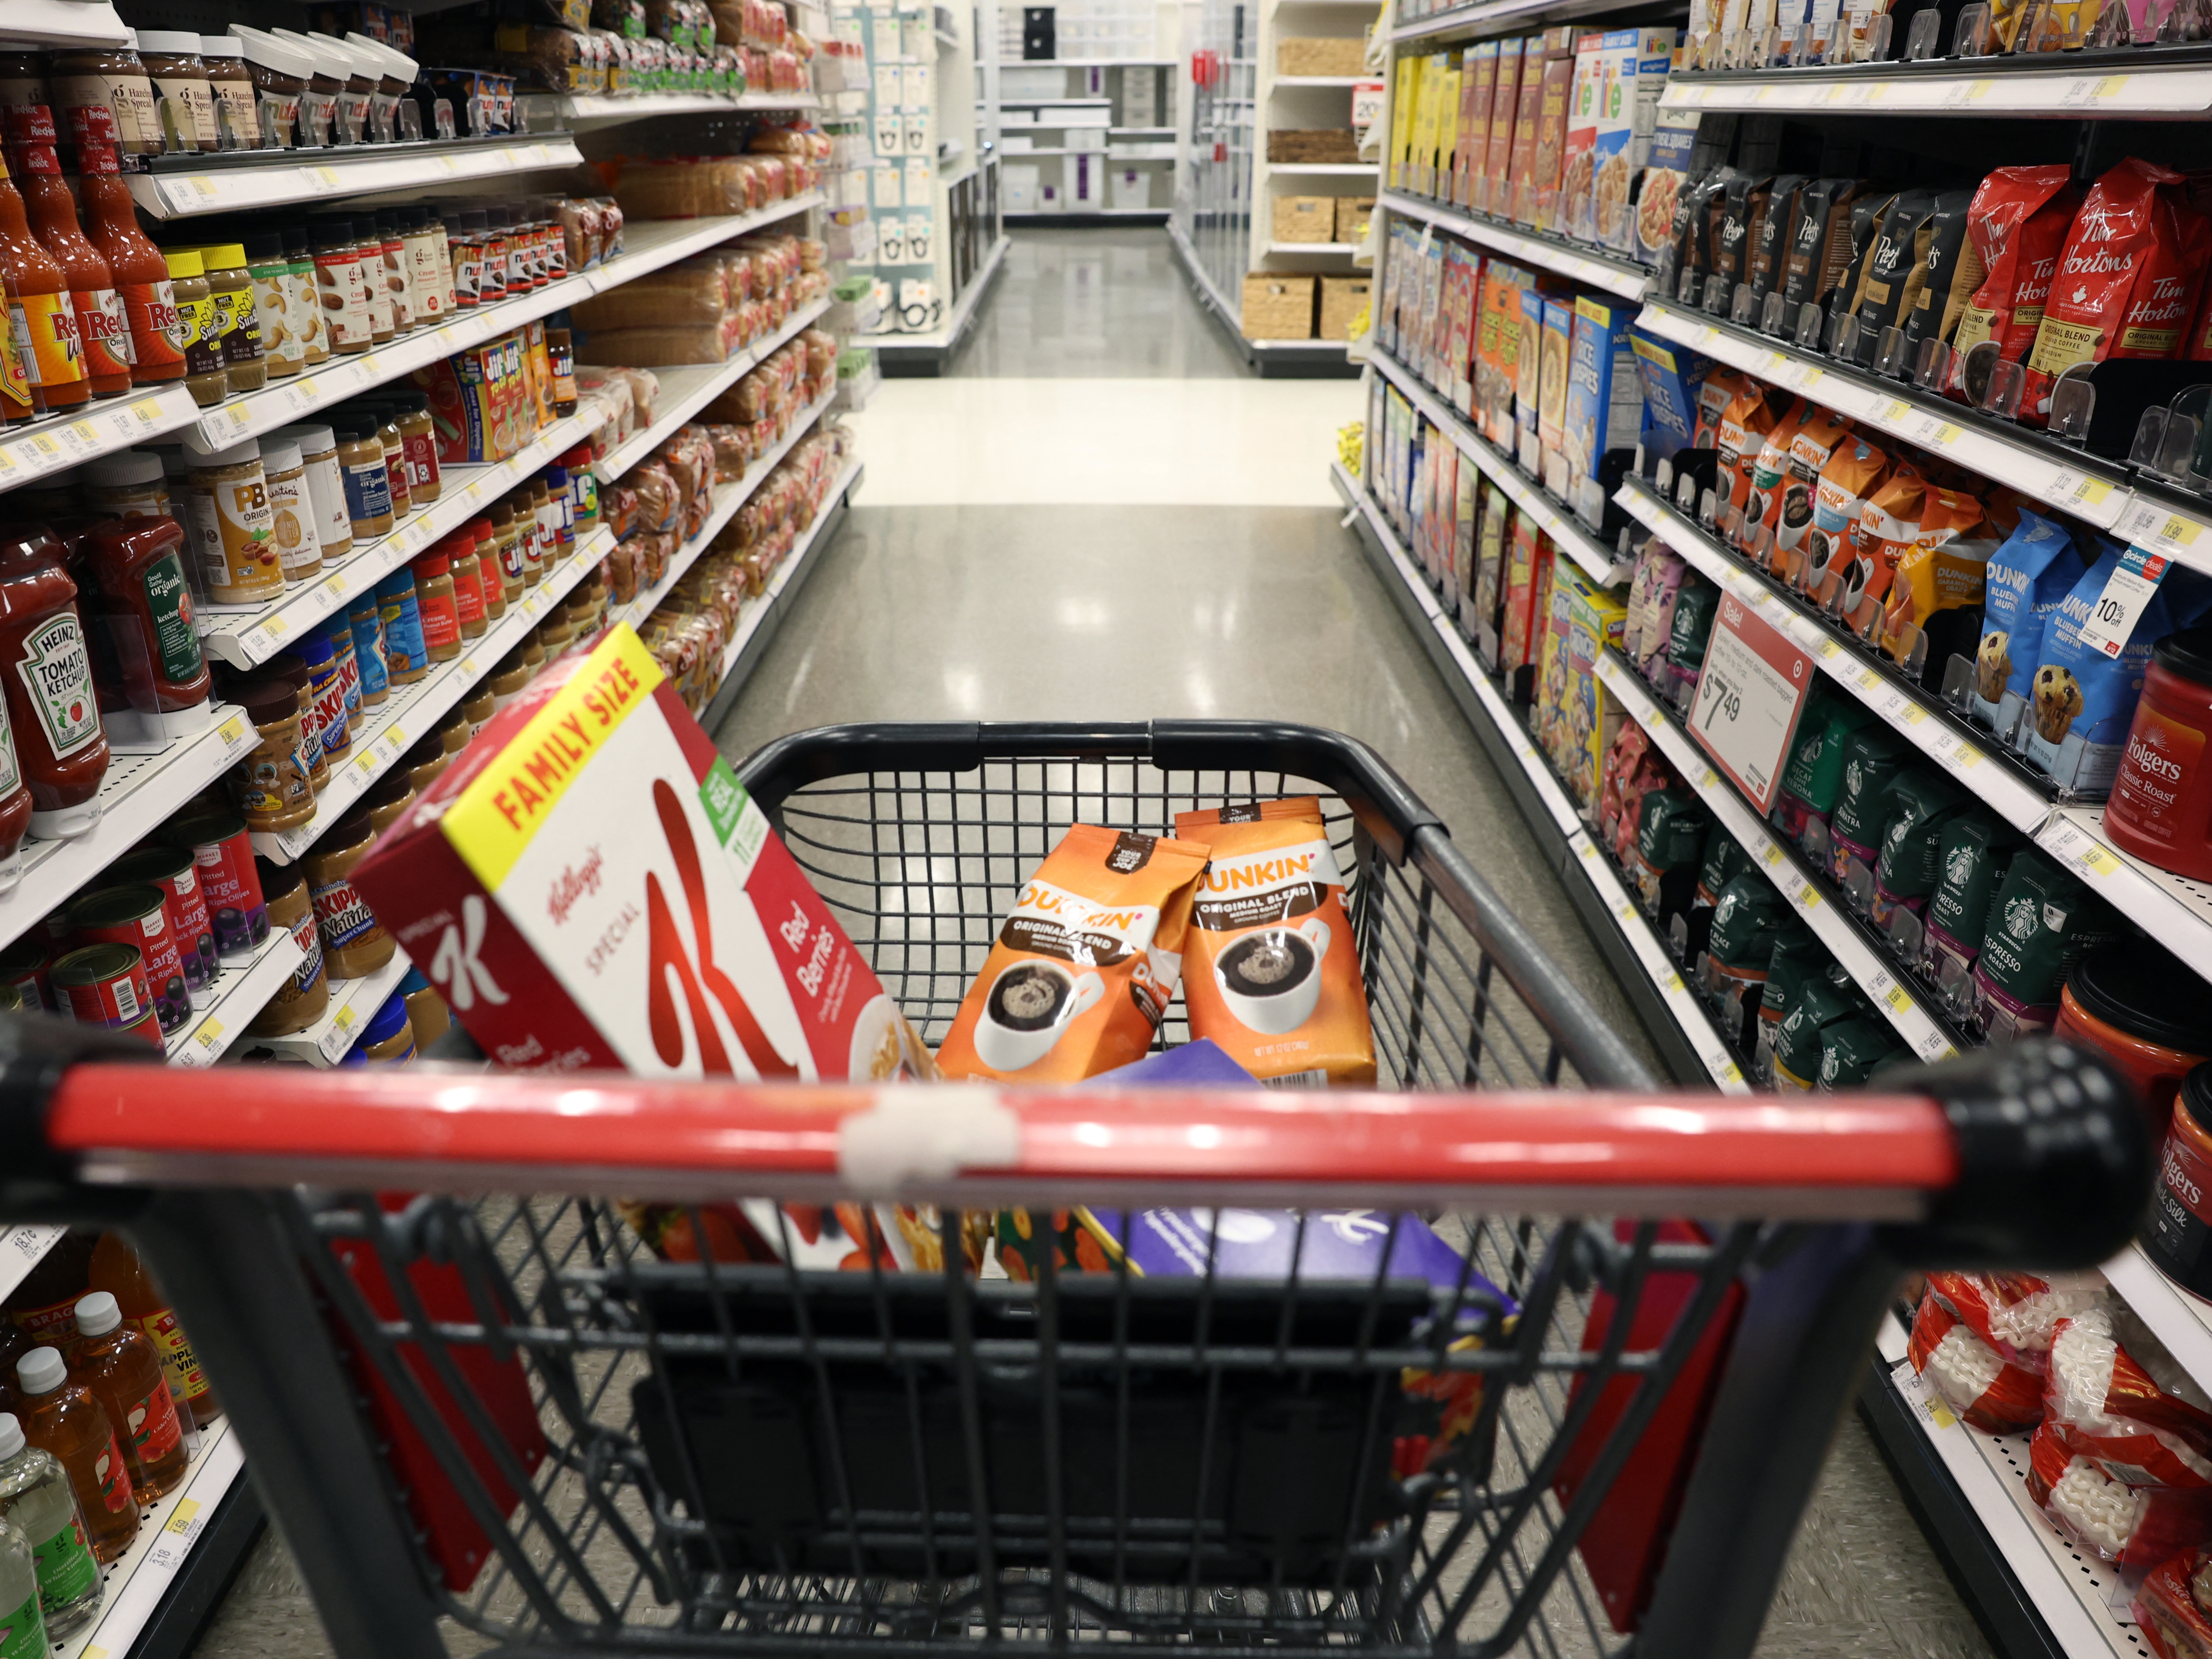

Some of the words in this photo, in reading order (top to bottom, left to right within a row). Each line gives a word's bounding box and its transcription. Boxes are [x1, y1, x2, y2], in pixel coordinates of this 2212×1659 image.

[131, 99, 152, 107] Spread
[88, 109, 110, 119] RedHot
[31, 126, 56, 136] RedHot
[100, 161, 118, 170] RedHot
[2081, 213, 2117, 243] Tim
[1874, 236, 1901, 269] Peet's
[2061, 244, 2132, 276] Hortons
[2153, 276, 2184, 300] Tim
[2045, 324, 2064, 337] ORIGINAL
[2064, 330, 2090, 343] BLEND
[2127, 332, 2163, 341] ORIGINAL
[2059, 340, 2081, 349] COFFEE
[505, 345, 519, 373] Jif
[2046, 350, 2061, 358] MEDIUM
[486, 353, 505, 381] Jif
[553, 358, 573, 376] Jif
[1793, 439, 1825, 467] DUNKIN'
[2161, 525, 2183, 540] 11.99
[2129, 552, 2147, 565] circle
[2146, 559, 2163, 572] deals
[149, 578, 163, 588] Gather
[151, 574, 180, 596] organic
[2112, 577, 2122, 585] Premium
[2115, 572, 2127, 582] Starbucks
[157, 609, 179, 623] ketchup
[1724, 601, 1743, 628] Sale!
[2111, 618, 2122, 628] off
[41, 625, 74, 653] HEINZ
[2055, 629, 2082, 649] MUFFIN
[2107, 644, 2116, 654] 4/12
[39, 648, 83, 683] TOMATO
[1730, 644, 1745, 661] medium
[1763, 671, 1777, 689] roasted
[1777, 684, 1793, 704] bagged
[47, 666, 85, 697] KETCHUP
[491, 711, 592, 831] FAMILY
[583, 657, 640, 726] SIZE
[1935, 735, 1952, 749] 15.25
[1952, 747, 1969, 761] 10.49
[2127, 734, 2182, 780] Folgers
[1792, 764, 1812, 782] DECAF
[1787, 775, 1813, 799] VERONA
[2121, 764, 2144, 788] Classic
[2144, 780, 2177, 804] Roast
[197, 851, 218, 860] MARKET
[2059, 831, 2079, 845] 9.07
[2082, 848, 2103, 865] 14.69
[1112, 861, 1134, 870] JOE
[1205, 853, 1315, 893] UNKIN'
[201, 871, 224, 881] Pitted
[203, 879, 239, 896] arge
[314, 879, 346, 894] Crunchy
[182, 895, 199, 910] Pitted
[208, 897, 226, 906] Ripe
[229, 890, 250, 902] Olives
[1200, 896, 1264, 913] ORIGINAL
[1267, 886, 1309, 903] BLEND
[174, 903, 206, 929] Large
[1229, 908, 1259, 918] MEDIUM
[1260, 902, 1282, 914] ROAST
[1936, 902, 1949, 917] ROAST
[145, 917, 162, 930] MARKET
[148, 923, 161, 933] PANTRY
[189, 922, 203, 936] Ripe
[780, 899, 809, 954] Red
[333, 932, 352, 946] Super
[353, 920, 373, 934] Chunk
[586, 901, 641, 977] SPECIAL
[1713, 932, 1731, 949] PLACE
[1998, 932, 2022, 952] STARBUCKS
[150, 937, 168, 953] Pitted
[430, 894, 510, 1011] K
[1985, 934, 2021, 972] ESPRESSO
[145, 945, 177, 973] Large
[796, 925, 835, 998] Berries
[1988, 953, 2006, 971] ROAST
[158, 966, 173, 979] Ripe
[303, 973, 315, 988] Super
[199, 1033, 213, 1048] 2.39
[1927, 1031, 1942, 1049] 14.65
[181, 1052, 195, 1067] 6.37
[2162, 1135, 2202, 1204] Folgers
[2166, 1198, 2187, 1227] Silk
[15, 1229, 38, 1252] 18.7¢
[172, 1519, 189, 1535] 1.59
[152, 1549, 171, 1567] 3.18
[45, 1570, 63, 1585] White
[65, 1550, 86, 1573] Vinegar
